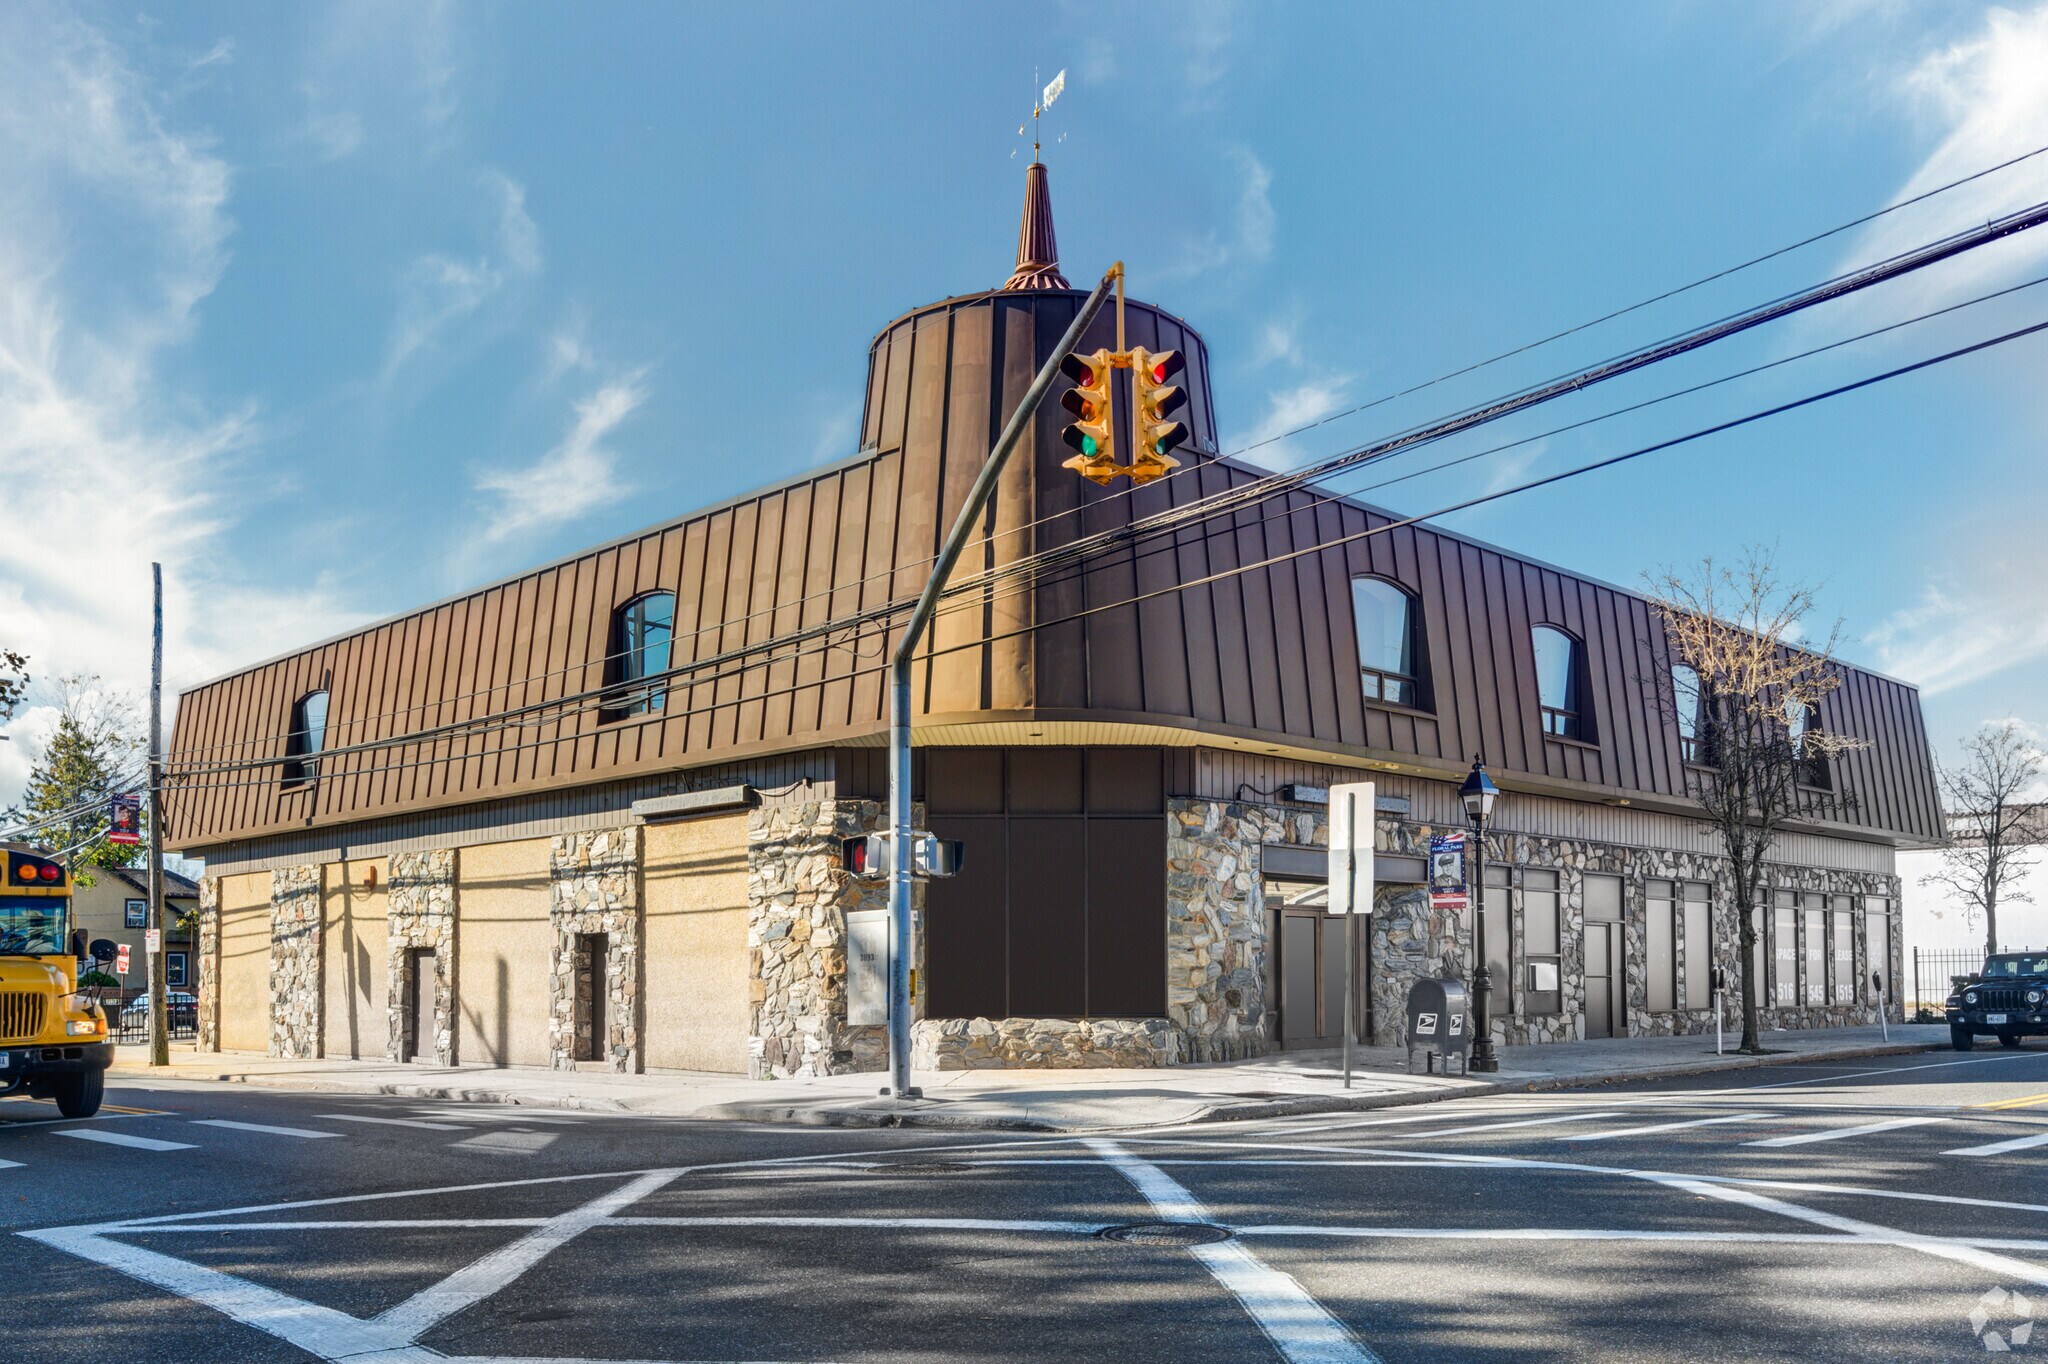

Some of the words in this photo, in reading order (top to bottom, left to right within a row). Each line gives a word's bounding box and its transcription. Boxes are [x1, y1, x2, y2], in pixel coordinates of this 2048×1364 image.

[1776, 948, 1796, 960] SPACE
[1809, 950, 1822, 960] FOR
[1836, 950, 1853, 961] LEASE
[1778, 982, 1794, 1000] 516
[1809, 984, 1824, 1001] 545
[1836, 984, 1854, 1001] 1515
